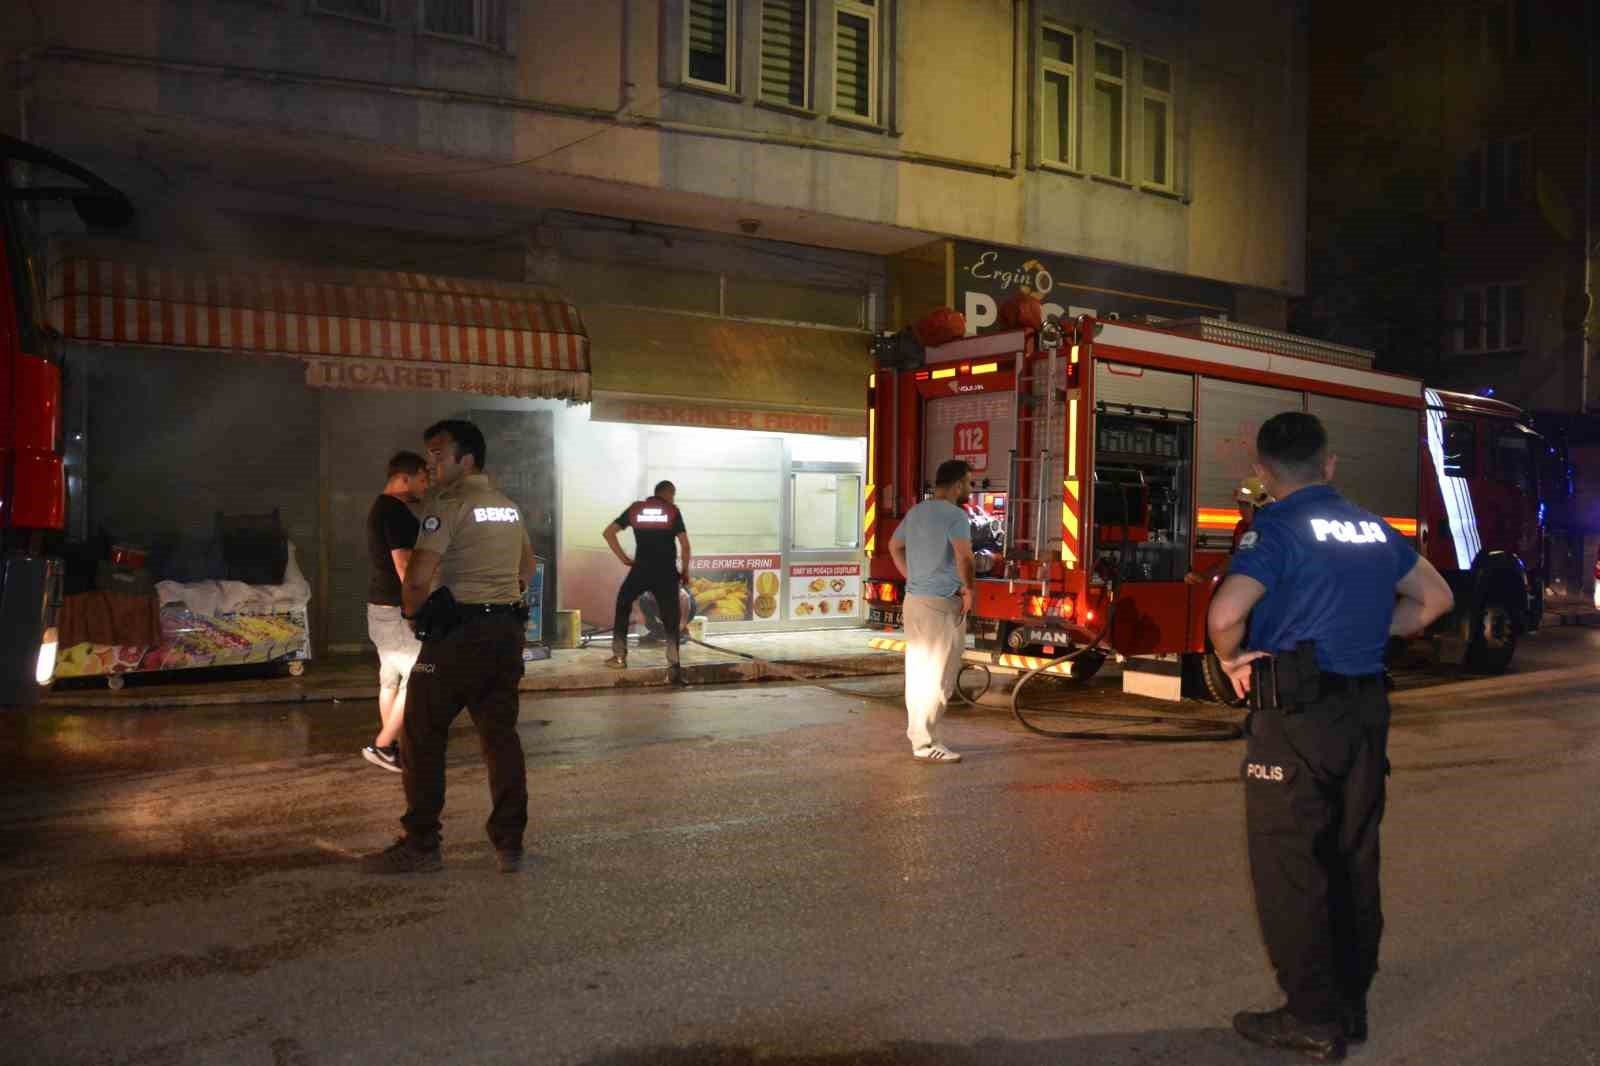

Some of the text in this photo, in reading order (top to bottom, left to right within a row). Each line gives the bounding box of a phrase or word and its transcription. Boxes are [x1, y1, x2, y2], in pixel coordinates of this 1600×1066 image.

[971, 251, 1031, 288] Ergin
[958, 427, 984, 451] 112
[712, 559, 745, 568] EKMEK
[1030, 630, 1067, 643] MAN
